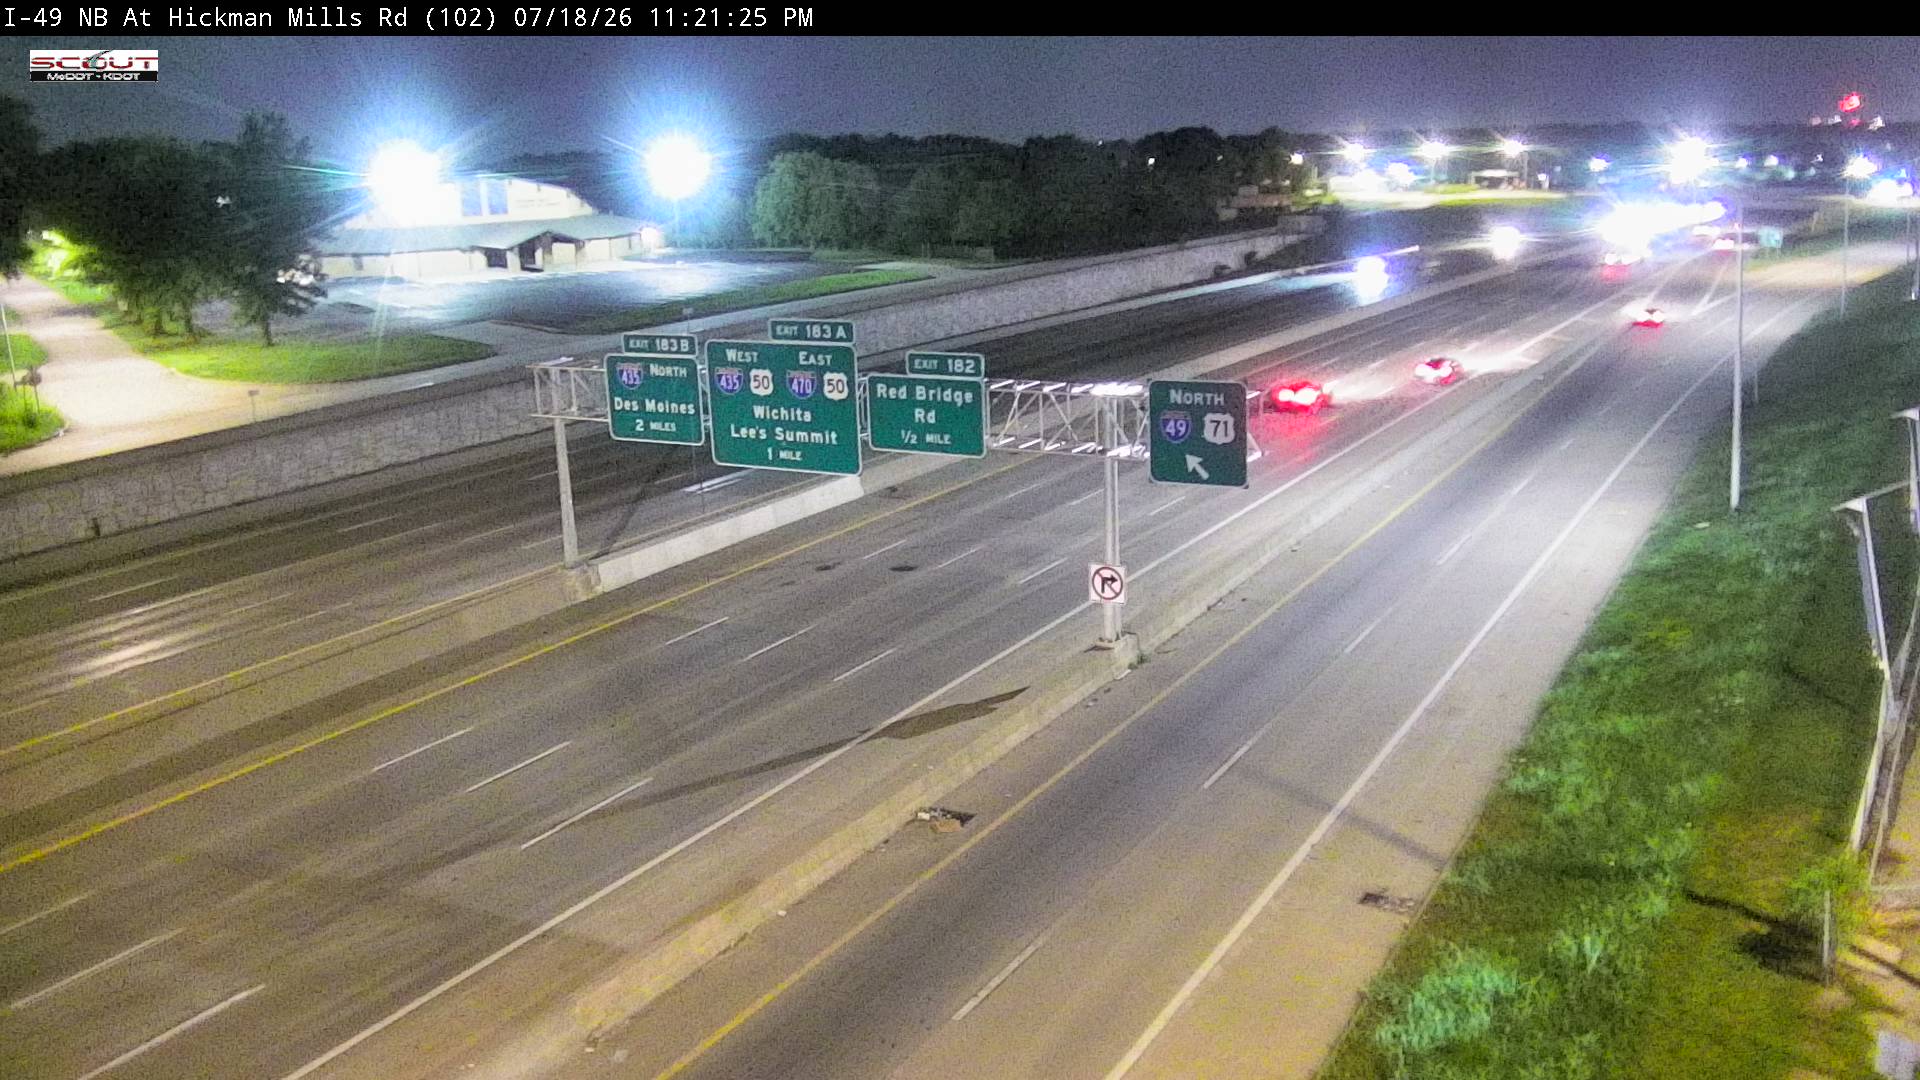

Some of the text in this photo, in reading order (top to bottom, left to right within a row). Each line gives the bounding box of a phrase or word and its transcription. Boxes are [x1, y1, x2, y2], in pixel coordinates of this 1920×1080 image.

[776, 324, 799, 336] EXIT
[629, 339, 649, 349] EXIT
[725, 348, 833, 366] WEST EAST
[914, 358, 976, 374] EXIT 182
[621, 363, 688, 385] 435 NORTH
[719, 374, 845, 394] 435 50 470 50
[876, 383, 974, 407] Red Bridge
[1169, 388, 1225, 406] NORTH
[614, 396, 696, 415] Des Moines
[752, 404, 813, 422] Wichita
[635, 418, 677, 432] 2 MILES
[914, 408, 936, 424] Rd
[730, 423, 838, 445] Lee's Summit
[1165, 419, 1229, 438] 49 71
[925, 432, 952, 445] MILE
[767, 446, 803, 461] 1 MILE
